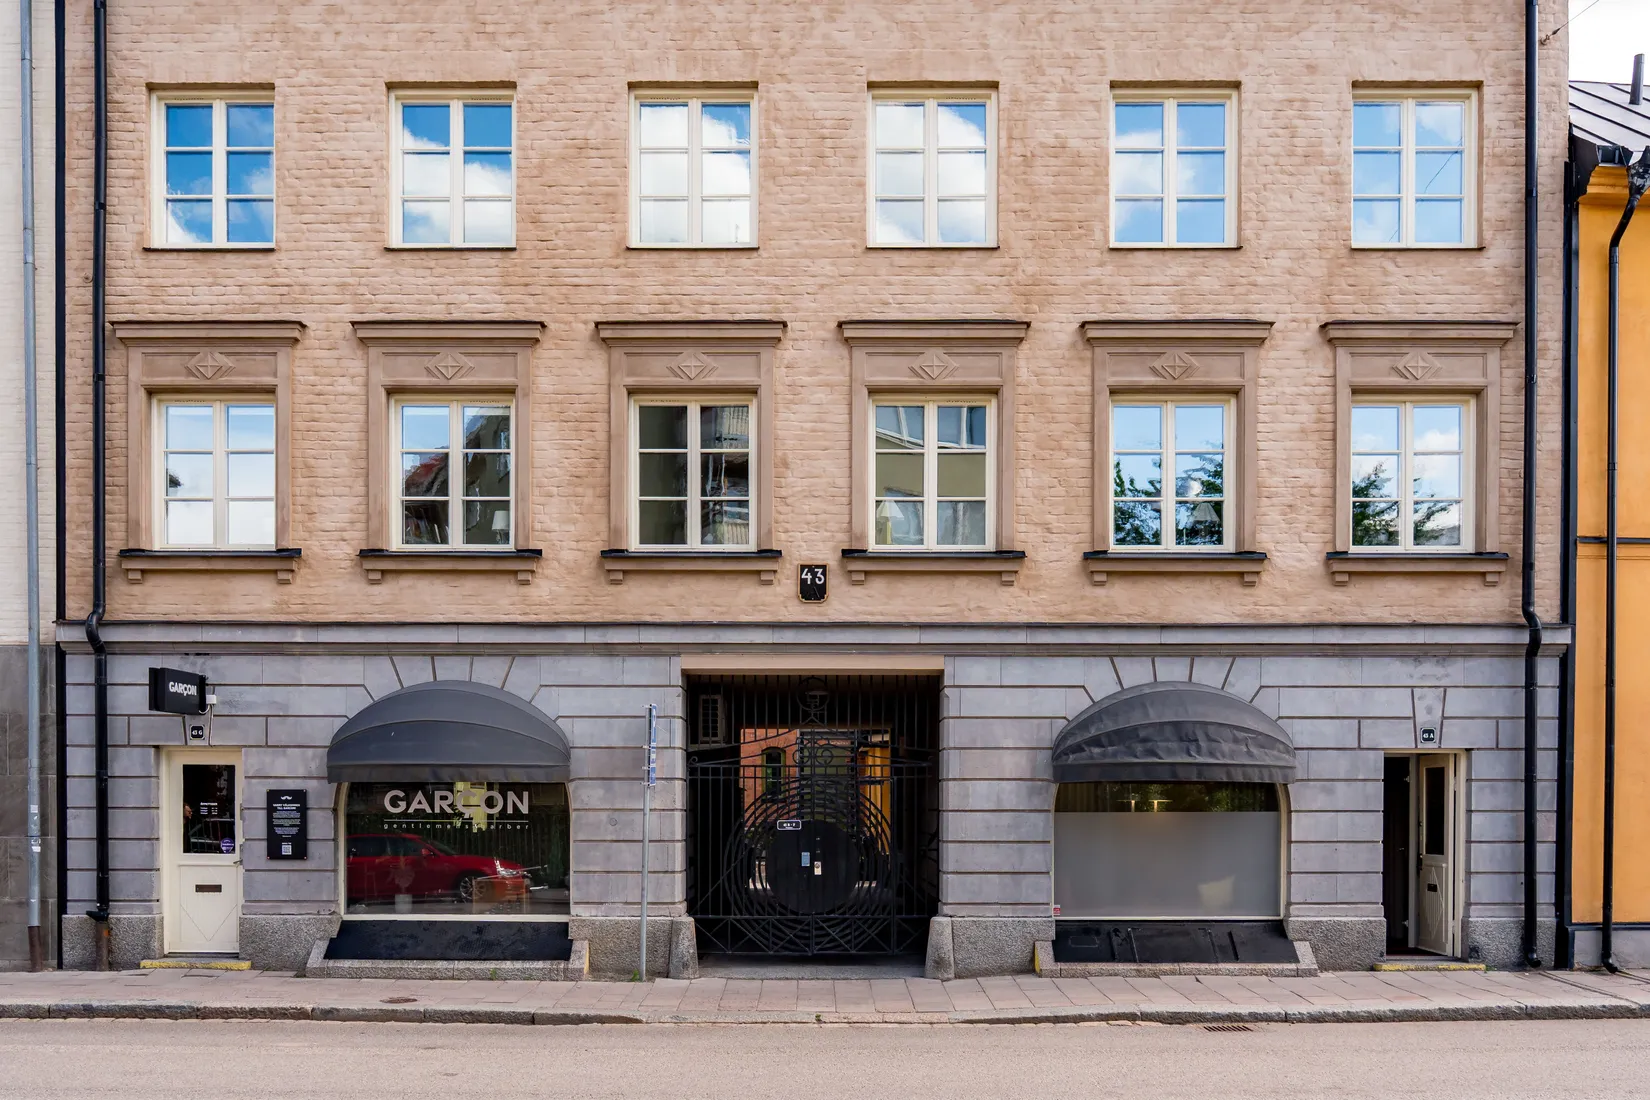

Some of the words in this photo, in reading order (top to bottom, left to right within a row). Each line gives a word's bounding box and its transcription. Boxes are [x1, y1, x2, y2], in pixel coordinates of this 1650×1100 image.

[801, 568, 825, 585] 43
[168, 681, 197, 696] GARÇON
[383, 789, 529, 819] GARÇON
